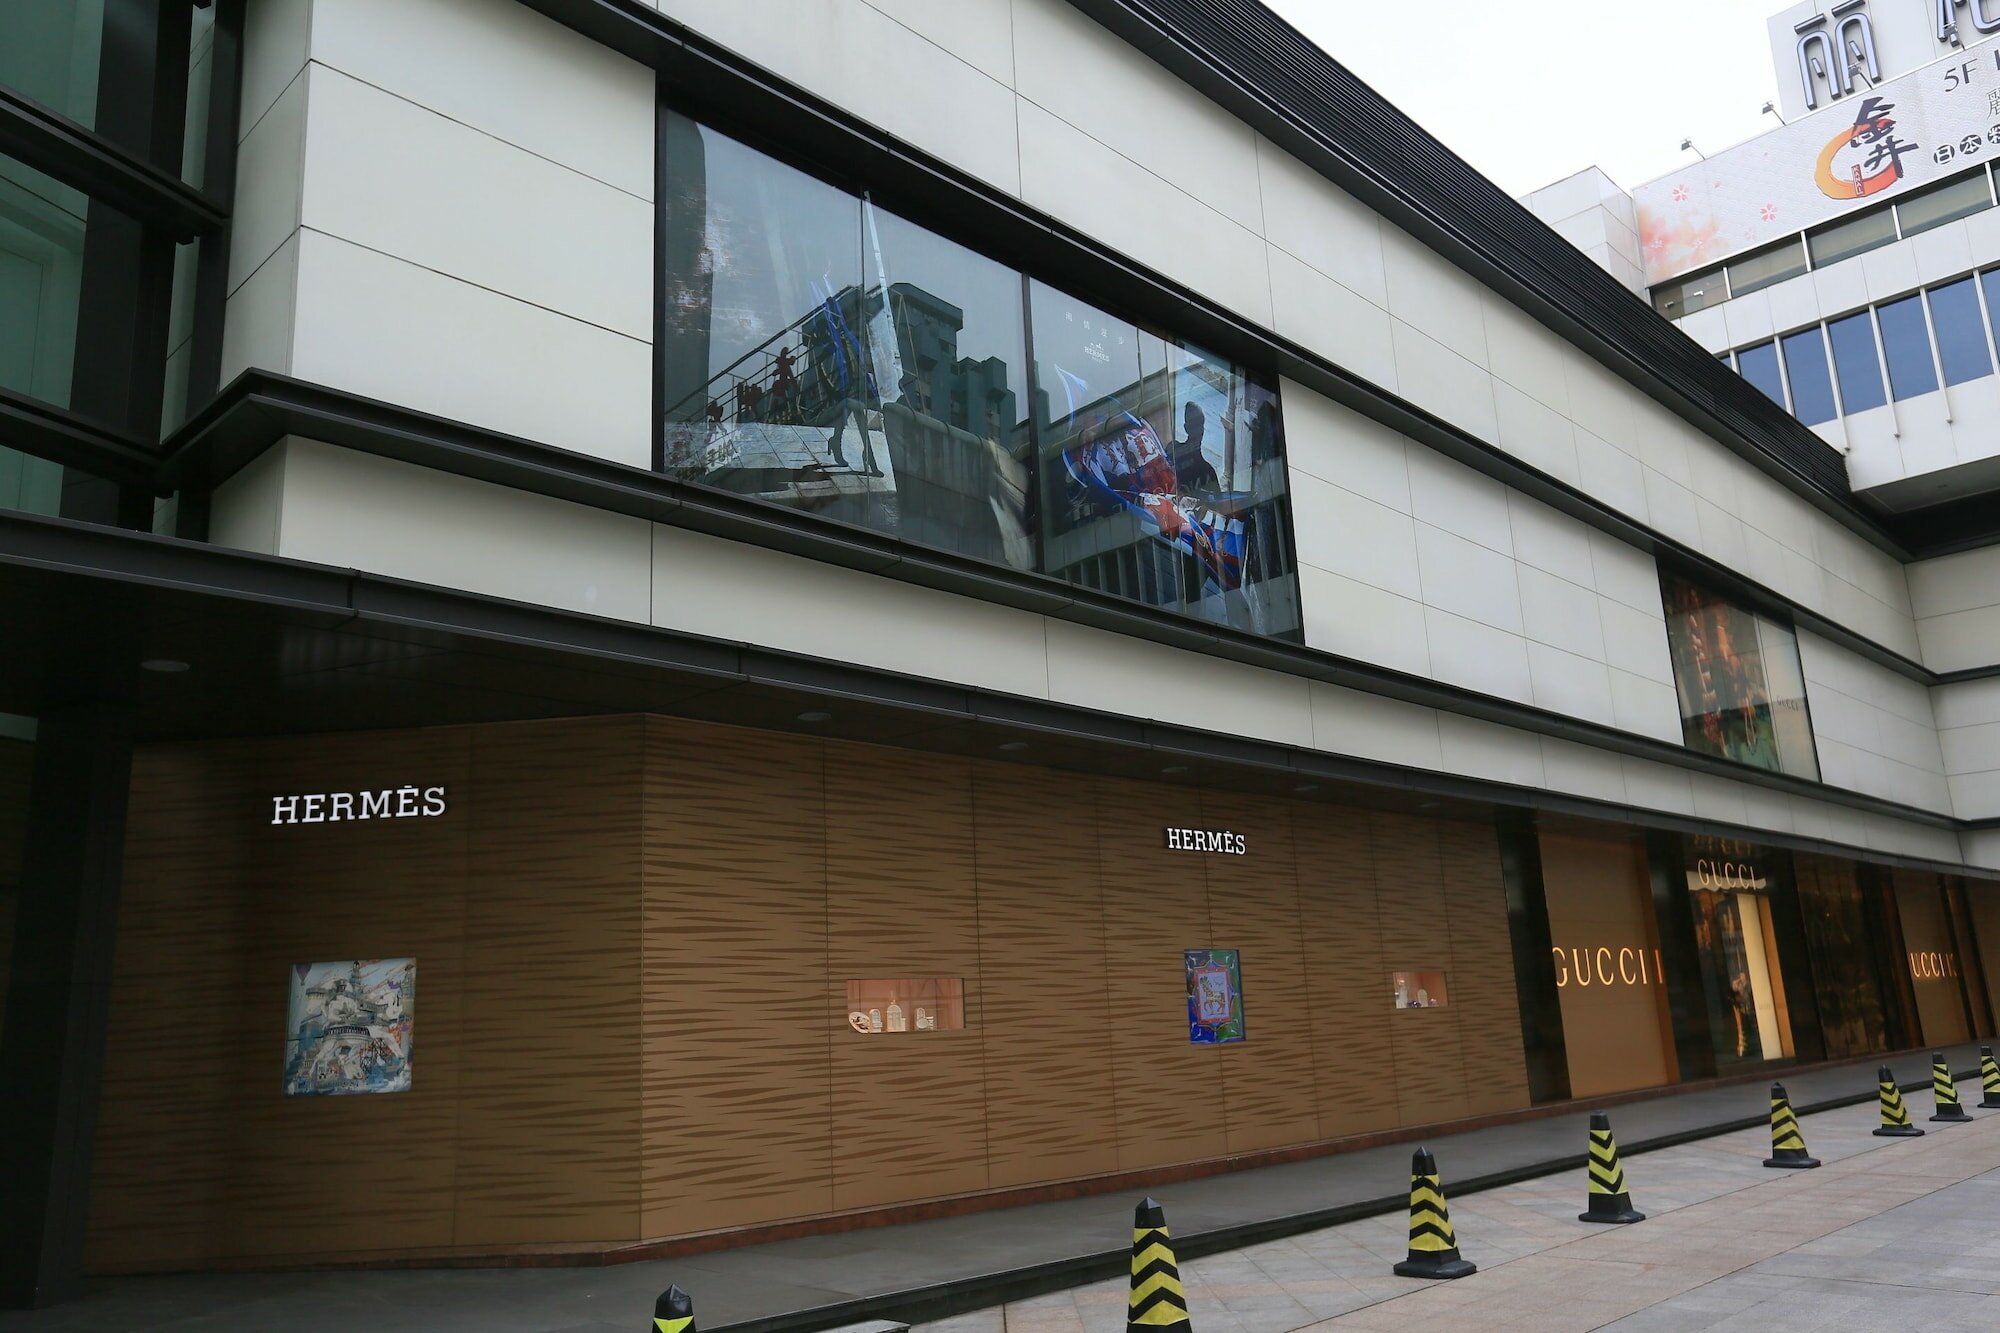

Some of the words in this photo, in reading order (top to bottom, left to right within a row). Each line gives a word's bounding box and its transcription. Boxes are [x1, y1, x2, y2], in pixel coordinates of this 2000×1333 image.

[1943, 58, 1979, 93] 5F
[1697, 859, 1756, 890] GUCCI
[1909, 951, 1945, 978] UCCI
